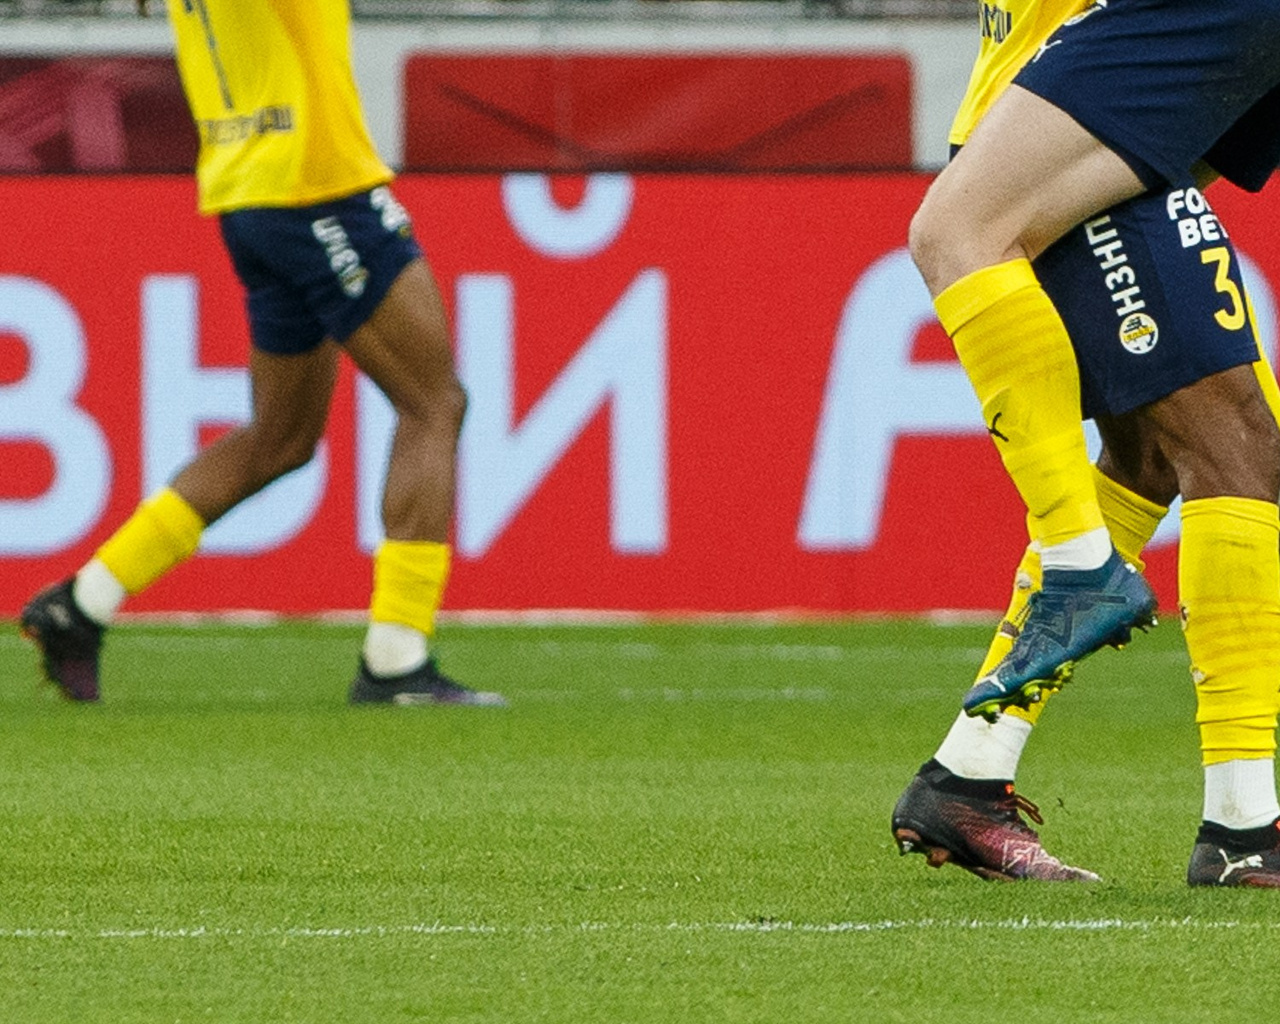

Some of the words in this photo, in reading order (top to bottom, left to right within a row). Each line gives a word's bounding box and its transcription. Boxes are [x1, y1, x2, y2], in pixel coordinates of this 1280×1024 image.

[1166, 187, 1213, 220] FO
[1177, 214, 1229, 249] BE
[1085, 215, 1146, 317] НЗНП
[1200, 246, 1246, 331] 3
